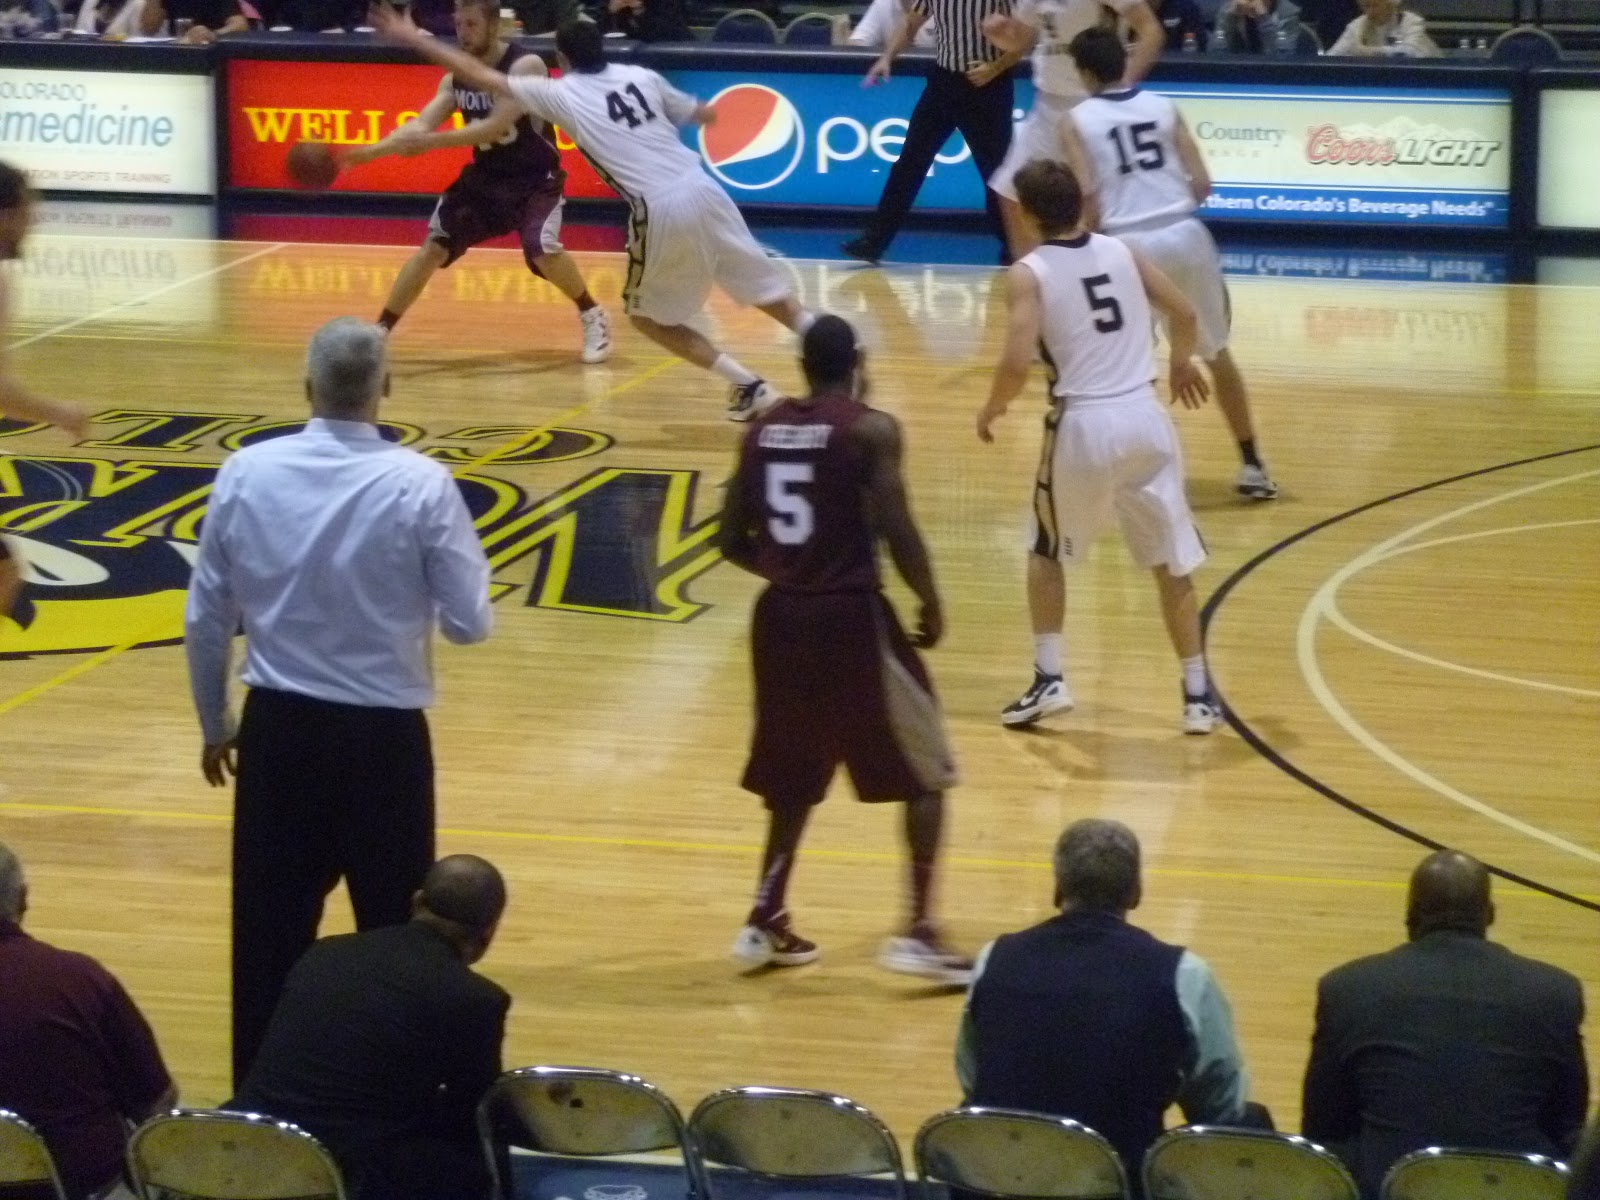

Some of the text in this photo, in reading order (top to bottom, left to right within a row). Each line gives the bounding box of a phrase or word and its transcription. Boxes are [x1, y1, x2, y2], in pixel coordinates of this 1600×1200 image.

[605, 81, 657, 128] 41
[1108, 120, 1165, 174] 15
[1196, 121, 1285, 148] Country
[1307, 123, 1501, 167] Coors LIGHT
[63, 170, 111, 182] SPORTS
[1255, 195, 1346, 212] Colorado's
[1348, 197, 1430, 218] Beverage
[1081, 273, 1125, 335] 5
[765, 461, 815, 546] 5
